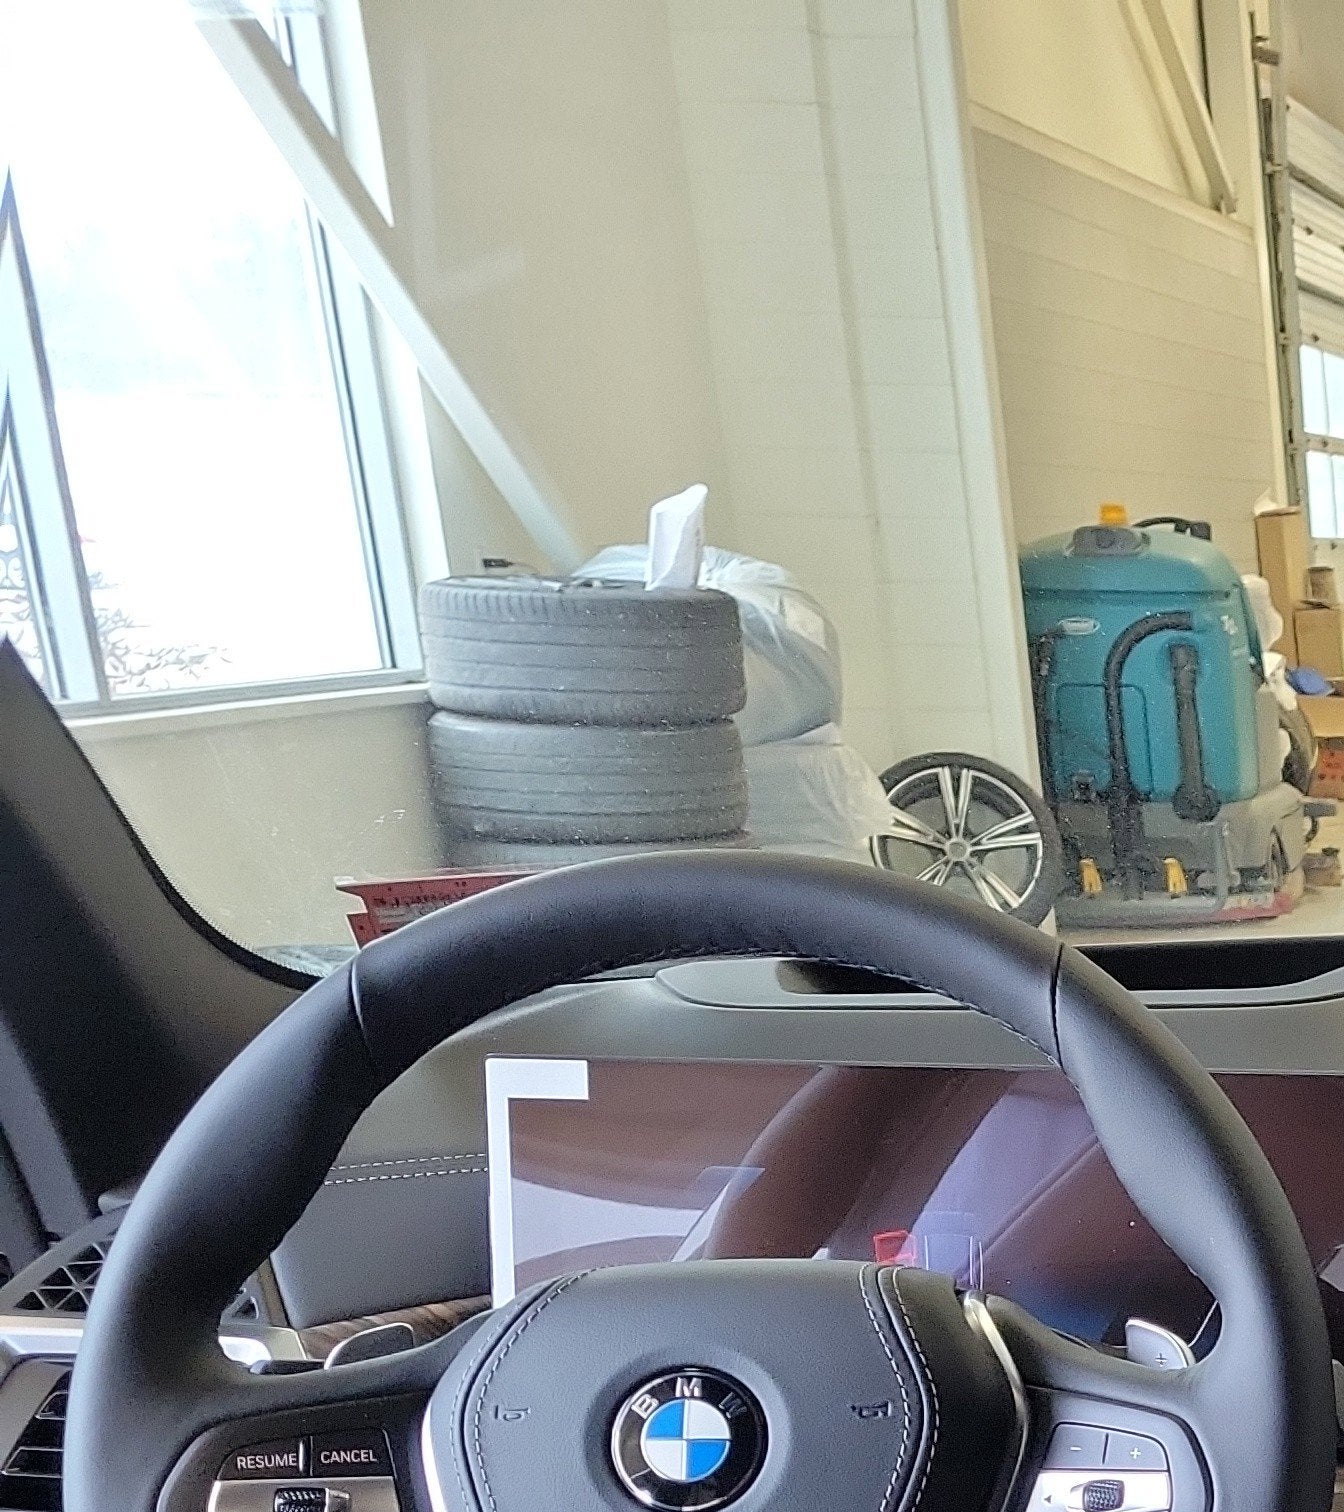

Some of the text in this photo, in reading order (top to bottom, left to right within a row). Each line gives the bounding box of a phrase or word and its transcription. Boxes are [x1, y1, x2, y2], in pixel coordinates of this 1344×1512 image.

[631, 1377, 748, 1419] BMW
[236, 1453, 297, 1470] RESUME
[320, 1449, 378, 1464] CANCEL
